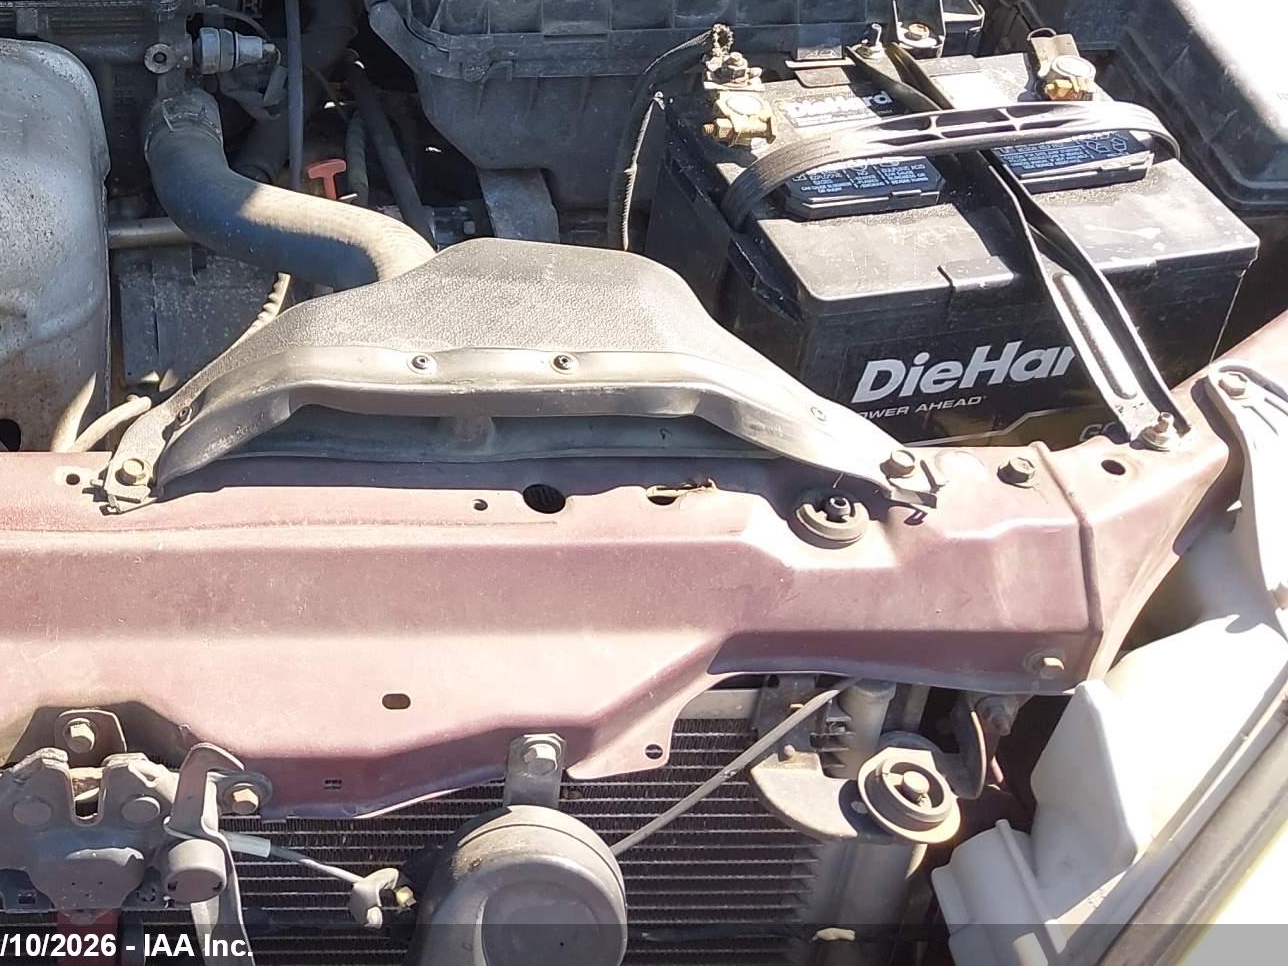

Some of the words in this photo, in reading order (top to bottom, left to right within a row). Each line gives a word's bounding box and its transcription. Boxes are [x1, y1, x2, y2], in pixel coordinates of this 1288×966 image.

[851, 340, 1077, 403] DieHar
[858, 405, 910, 420] OWER
[915, 396, 982, 412] AHEAD
